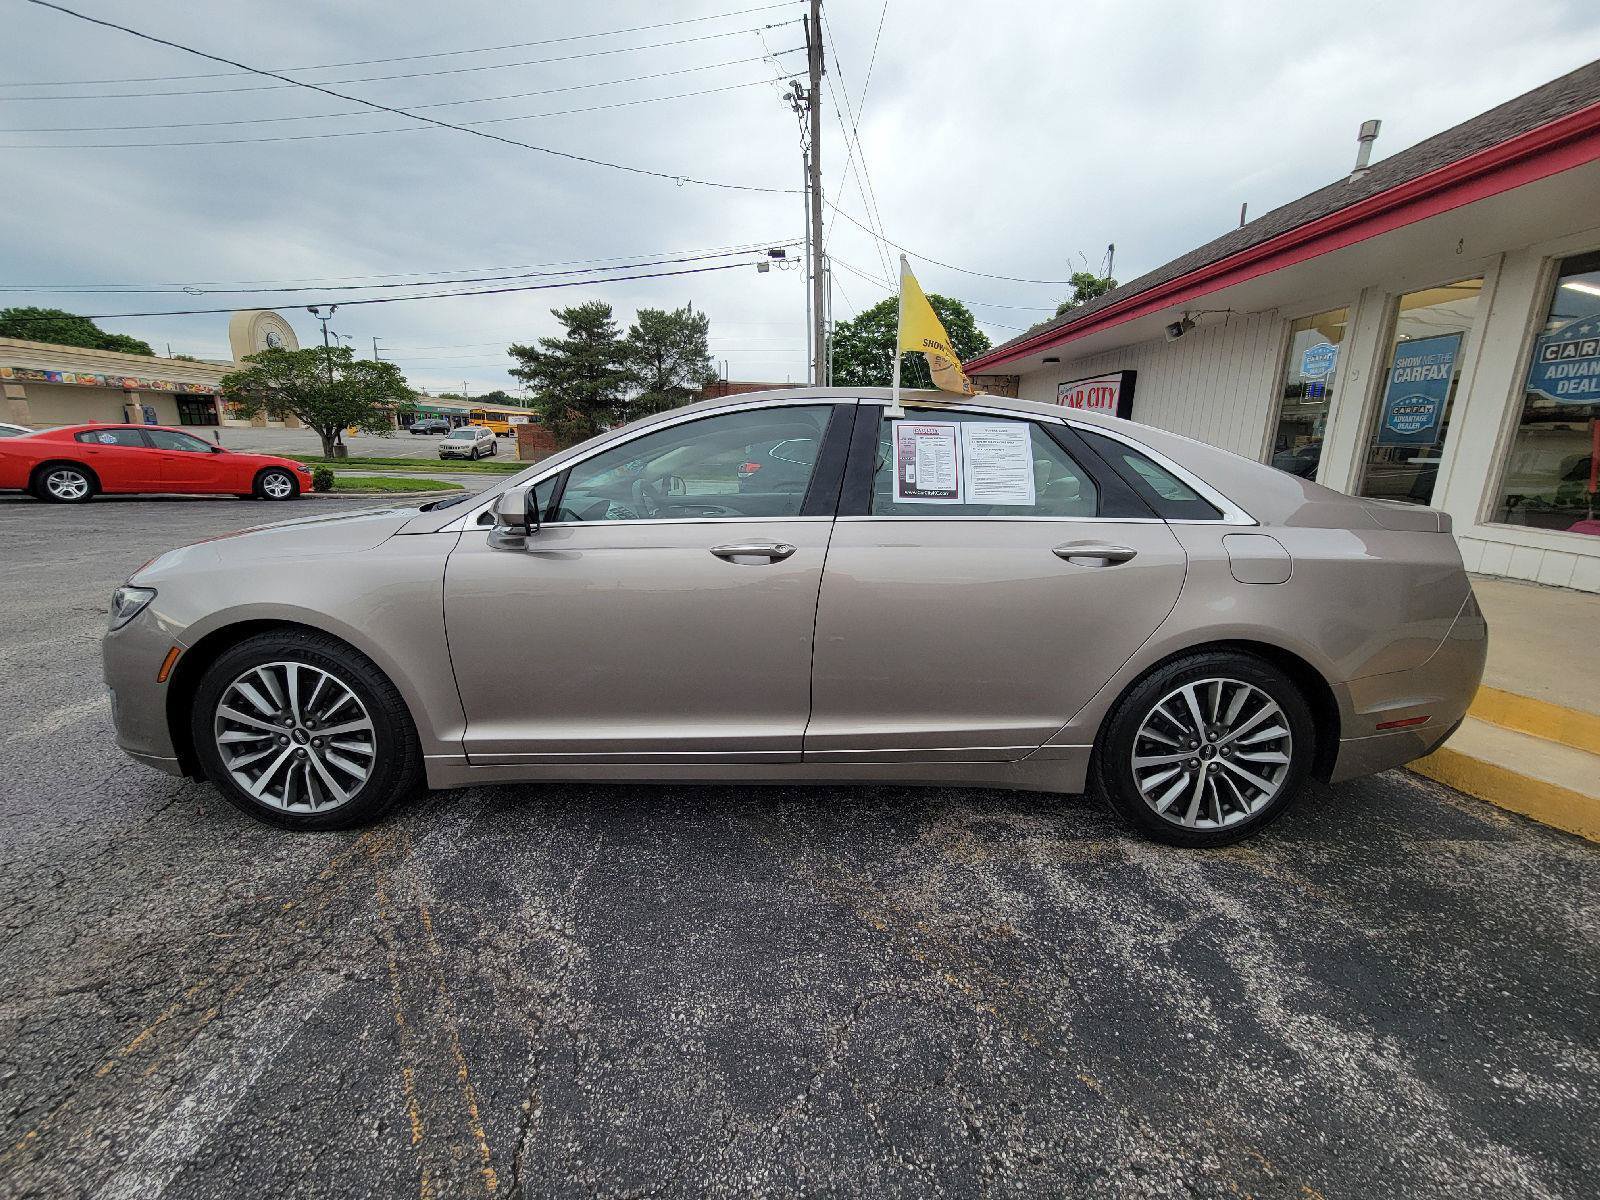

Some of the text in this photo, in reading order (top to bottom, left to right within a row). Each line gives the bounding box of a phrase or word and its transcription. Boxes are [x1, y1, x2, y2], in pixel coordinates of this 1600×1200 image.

[1396, 352, 1453, 369] SHOW ME THE
[1394, 362, 1452, 384] CARFAX
[1556, 378, 1600, 394] DEAL
[1061, 390, 1084, 408] CAR
[1087, 387, 1117, 409] CITY
[1392, 404, 1433, 415] CARFAX
[1393, 414, 1427, 422] ADVANTAGE
[1397, 422, 1421, 430] DEALER
